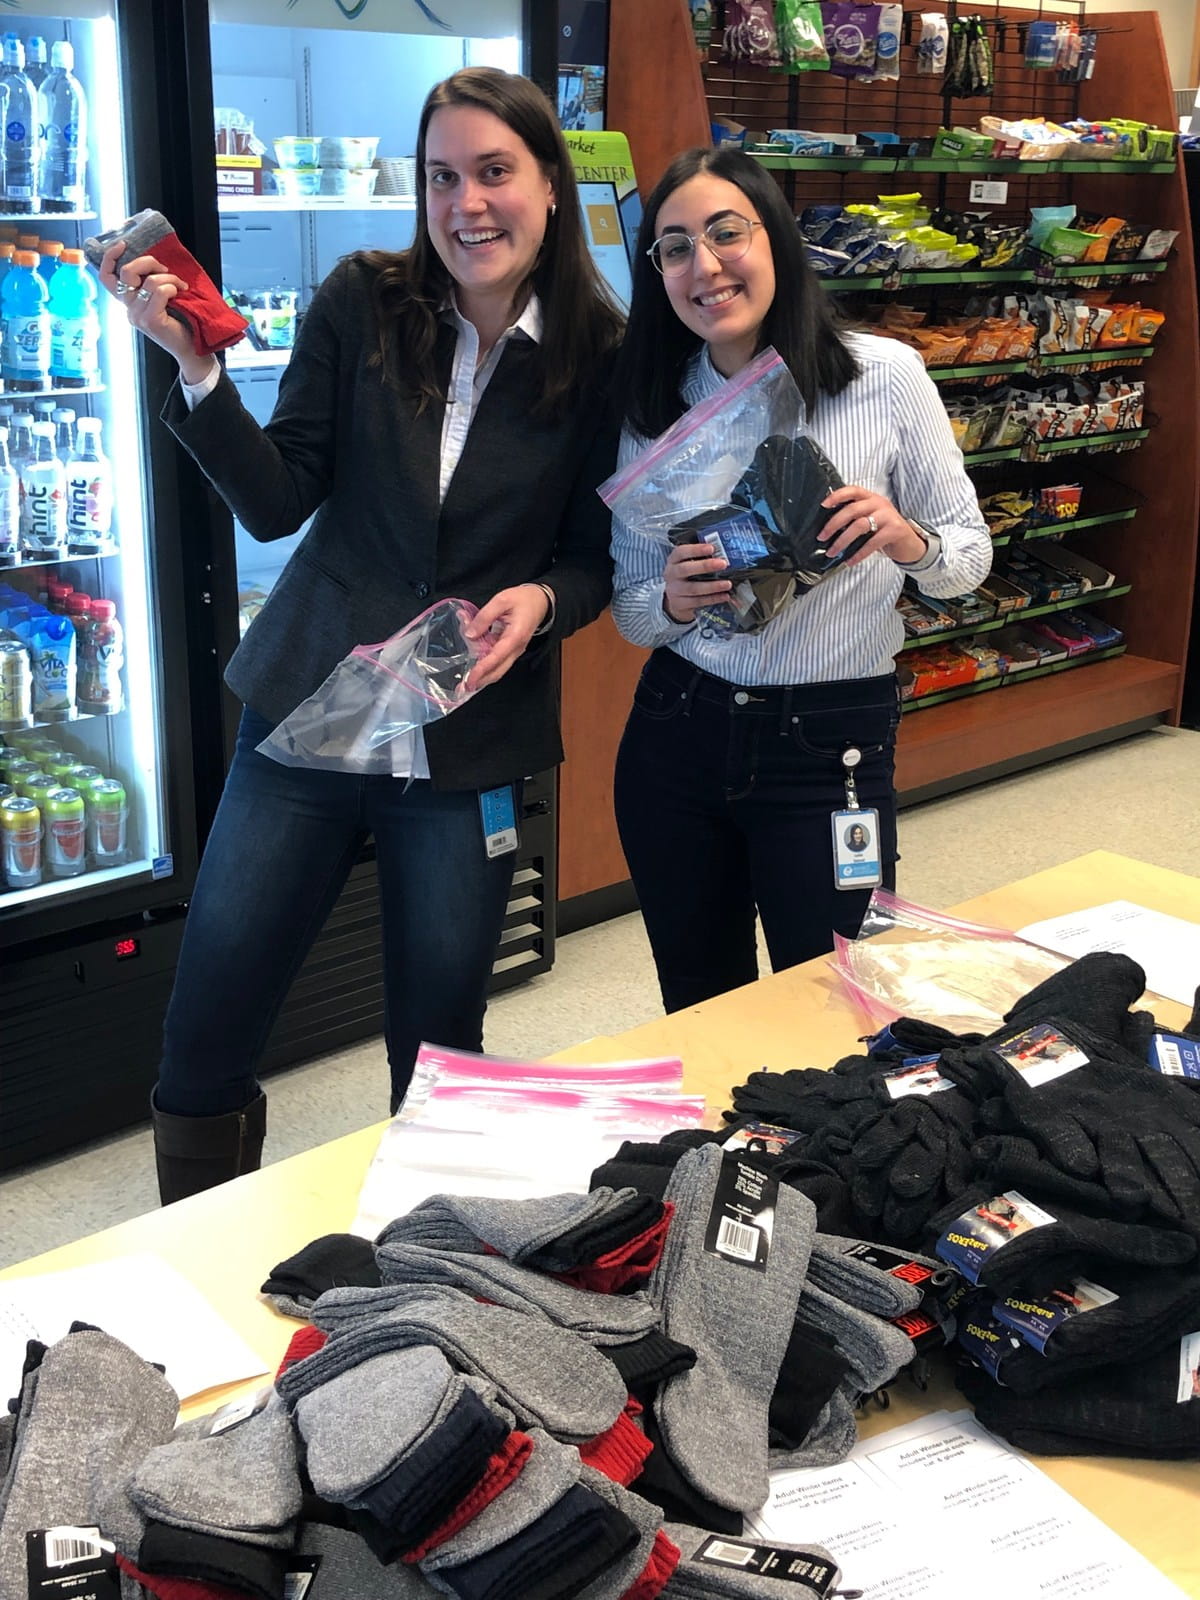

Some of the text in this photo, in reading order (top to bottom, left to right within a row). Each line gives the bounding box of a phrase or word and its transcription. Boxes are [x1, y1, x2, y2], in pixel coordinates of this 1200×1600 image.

[564, 136, 596, 154] arket
[29, 485, 48, 536] hint
[70, 479, 87, 527] hint
